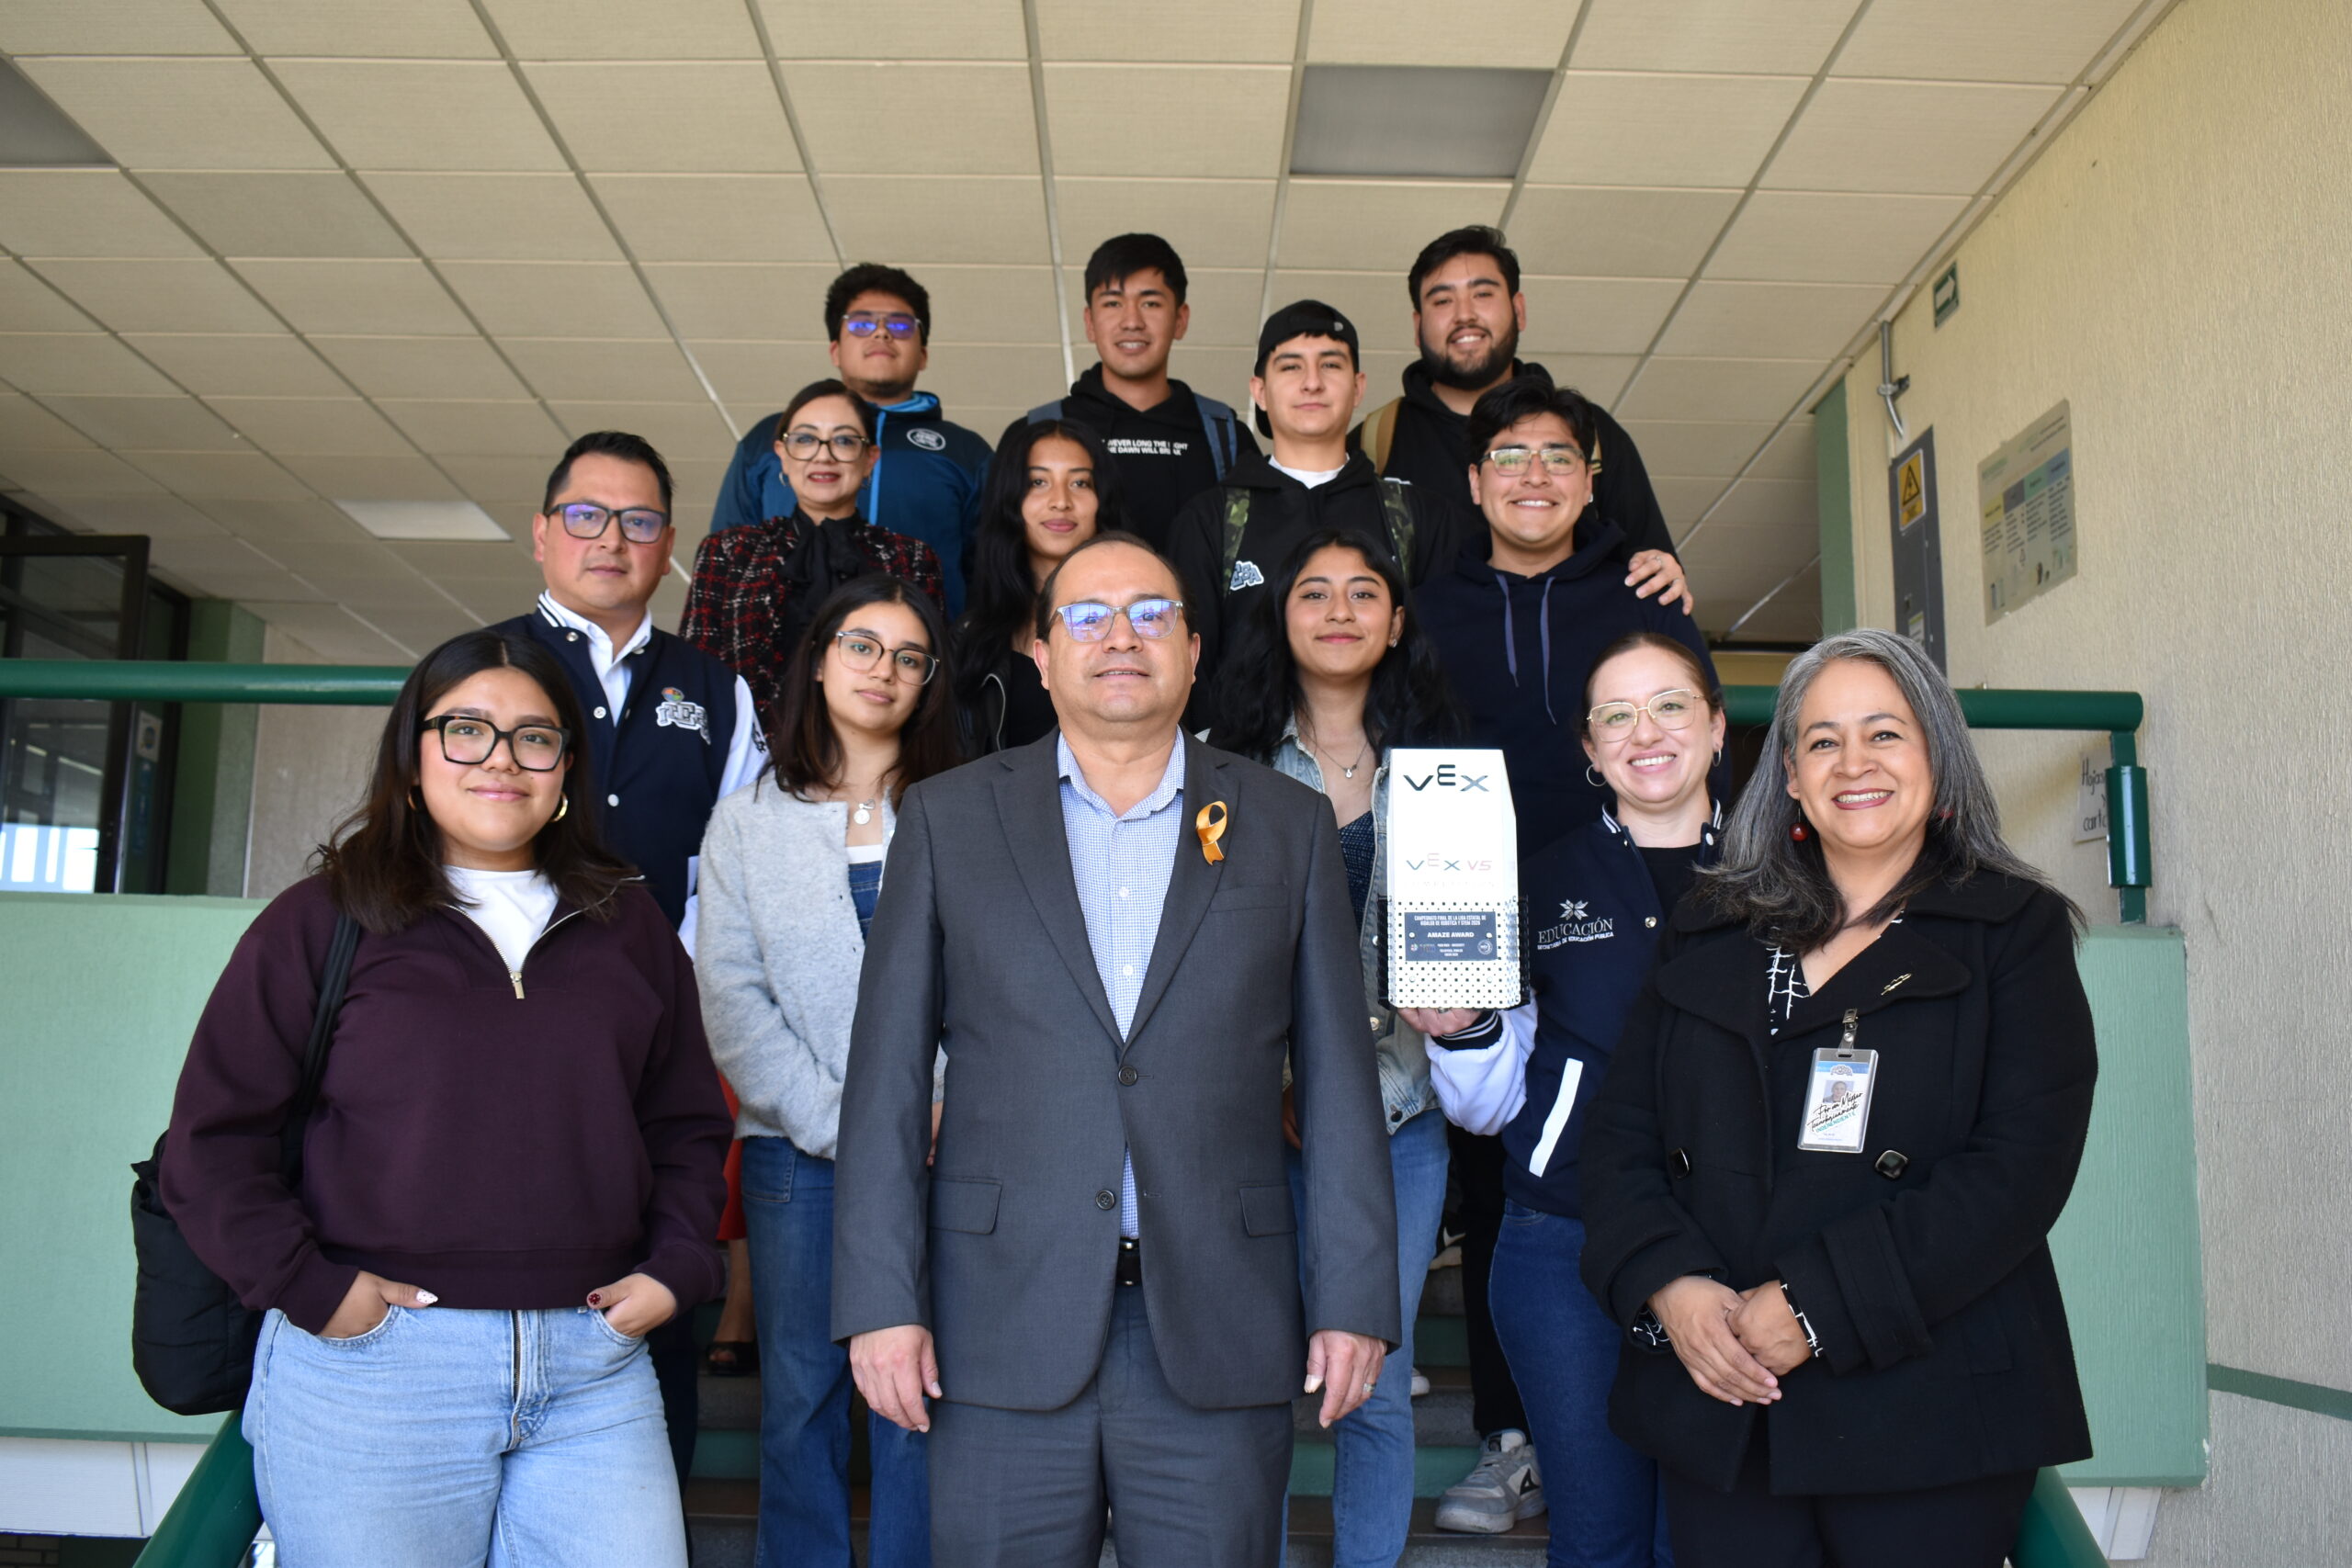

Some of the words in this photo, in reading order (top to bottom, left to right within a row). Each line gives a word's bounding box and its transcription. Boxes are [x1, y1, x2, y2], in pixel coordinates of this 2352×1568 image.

[1117, 446, 1141, 455] DAWN
[1132, 439, 1153, 448] LONG
[1153, 440, 1167, 448] THE
[1403, 763, 1490, 792] VEX
[1406, 852, 1462, 871] VEX
[1466, 860, 1494, 871] V5
[1538, 917, 1613, 943] EDUCACIÓN
